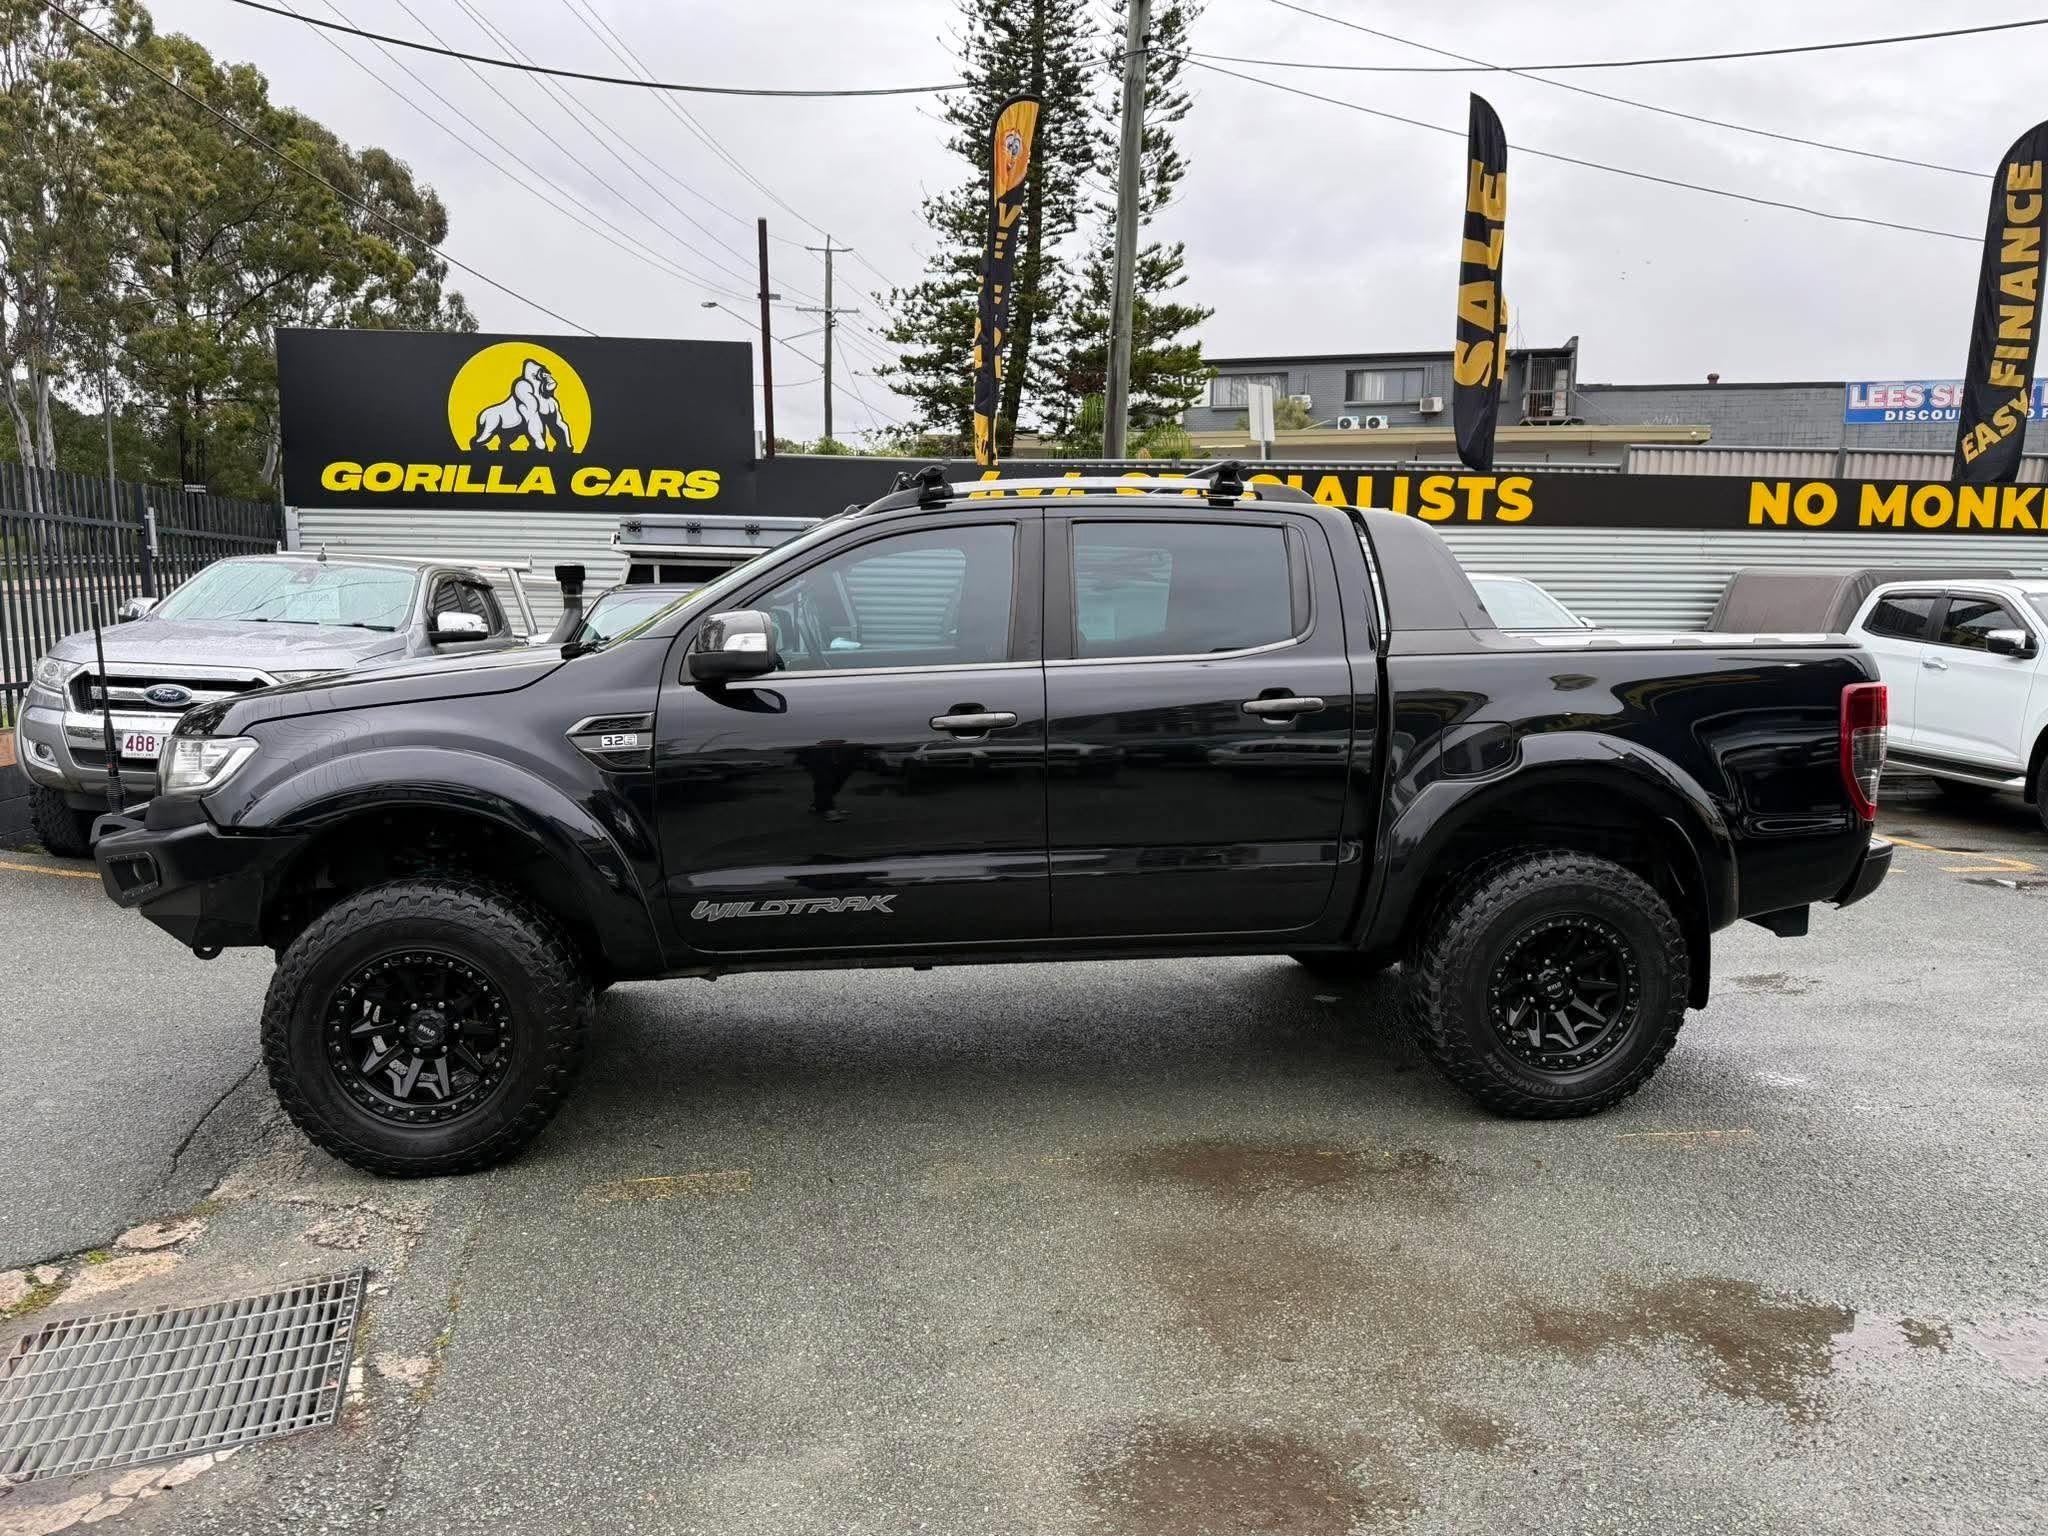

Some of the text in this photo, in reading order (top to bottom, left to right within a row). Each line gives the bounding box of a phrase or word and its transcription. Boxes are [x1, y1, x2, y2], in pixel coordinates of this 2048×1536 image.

[1453, 158, 1506, 387] SALE
[1961, 161, 2042, 464] EASY FINANCE
[1849, 384, 1923, 409] LEES
[1884, 410, 1962, 421] DISCOU
[321, 462, 720, 499] GORILLA CARS
[1749, 482, 2048, 529] NO MONK
[125, 735, 155, 752] 488
[691, 894, 898, 921] WILDTRAK
